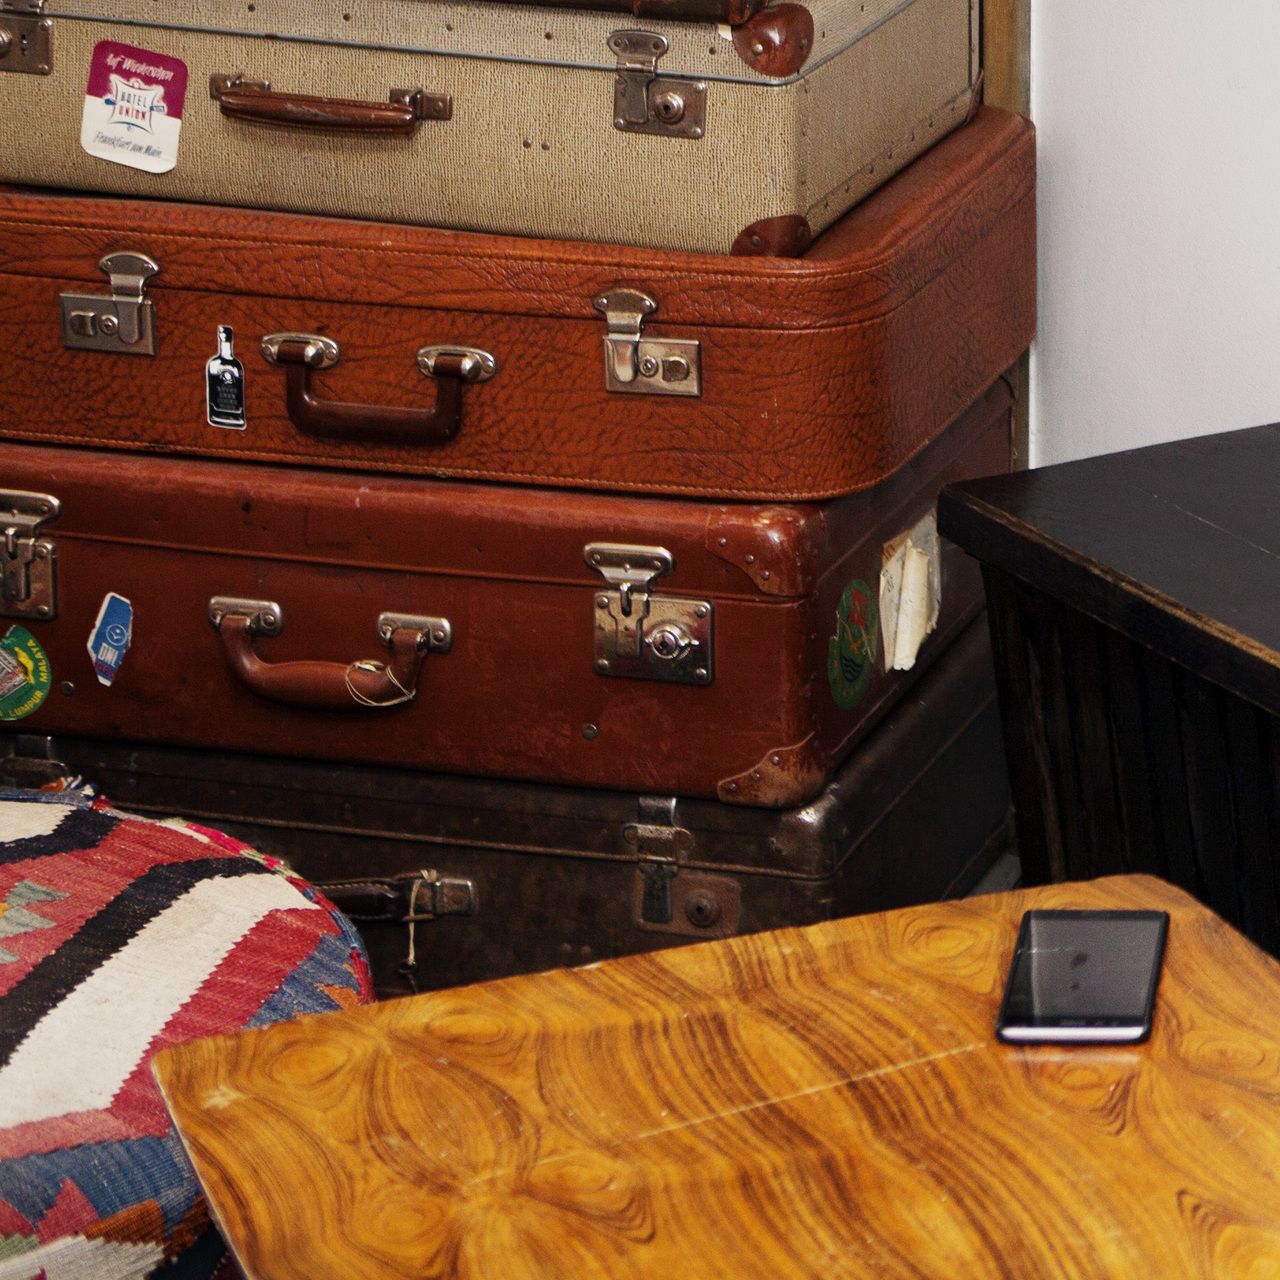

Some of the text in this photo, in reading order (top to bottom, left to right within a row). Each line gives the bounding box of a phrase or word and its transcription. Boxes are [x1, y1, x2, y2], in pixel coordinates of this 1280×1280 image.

[118, 107, 147, 121] UNION
[120, 91, 148, 109] HOTEL
[93, 131, 163, 159] Frankfurt am Main
[27, 639, 49, 683] MALAYA
[9, 689, 44, 718] LUMPUR
